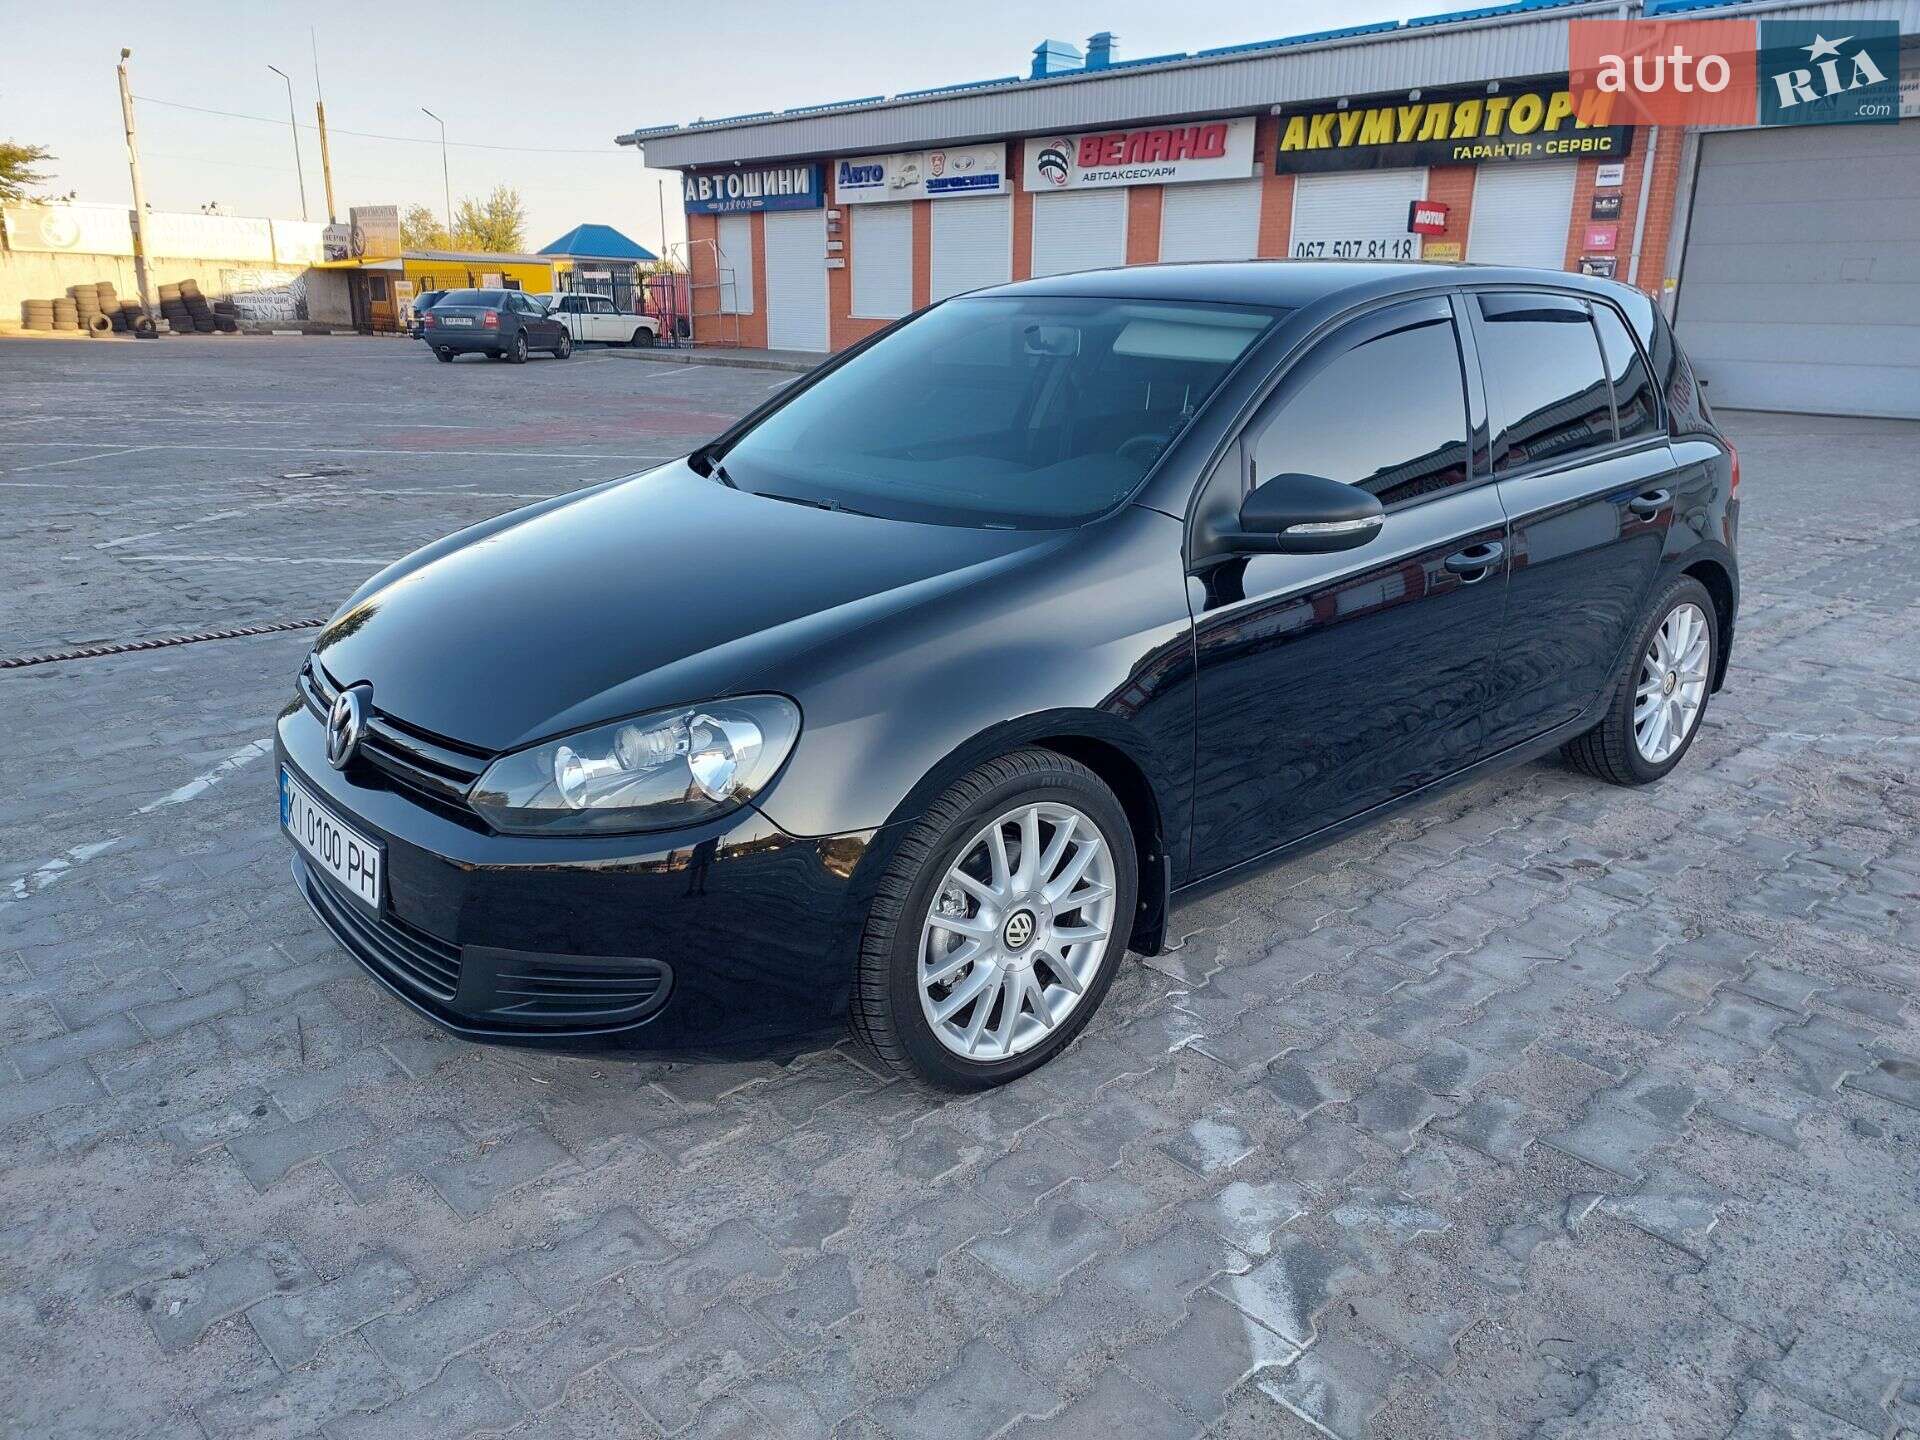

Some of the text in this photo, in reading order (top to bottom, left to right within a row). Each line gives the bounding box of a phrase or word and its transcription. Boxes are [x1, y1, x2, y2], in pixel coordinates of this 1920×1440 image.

[1280, 89, 1616, 151] АКУМУЛЯТОРИ
[1078, 124, 1228, 167] ВЕЛАНД
[1453, 136, 1613, 160] ГАРАНТІЯ СЕРВІС
[685, 168, 810, 202] АВТОШИНИ
[1082, 166, 1177, 182] АВТОАКСЕСУАРИ
[1415, 210, 1446, 226] MOTUL
[1296, 242, 1326, 257] 067
[1333, 240, 1363, 258] 507
[288, 786, 376, 900] KI 0100 PH
